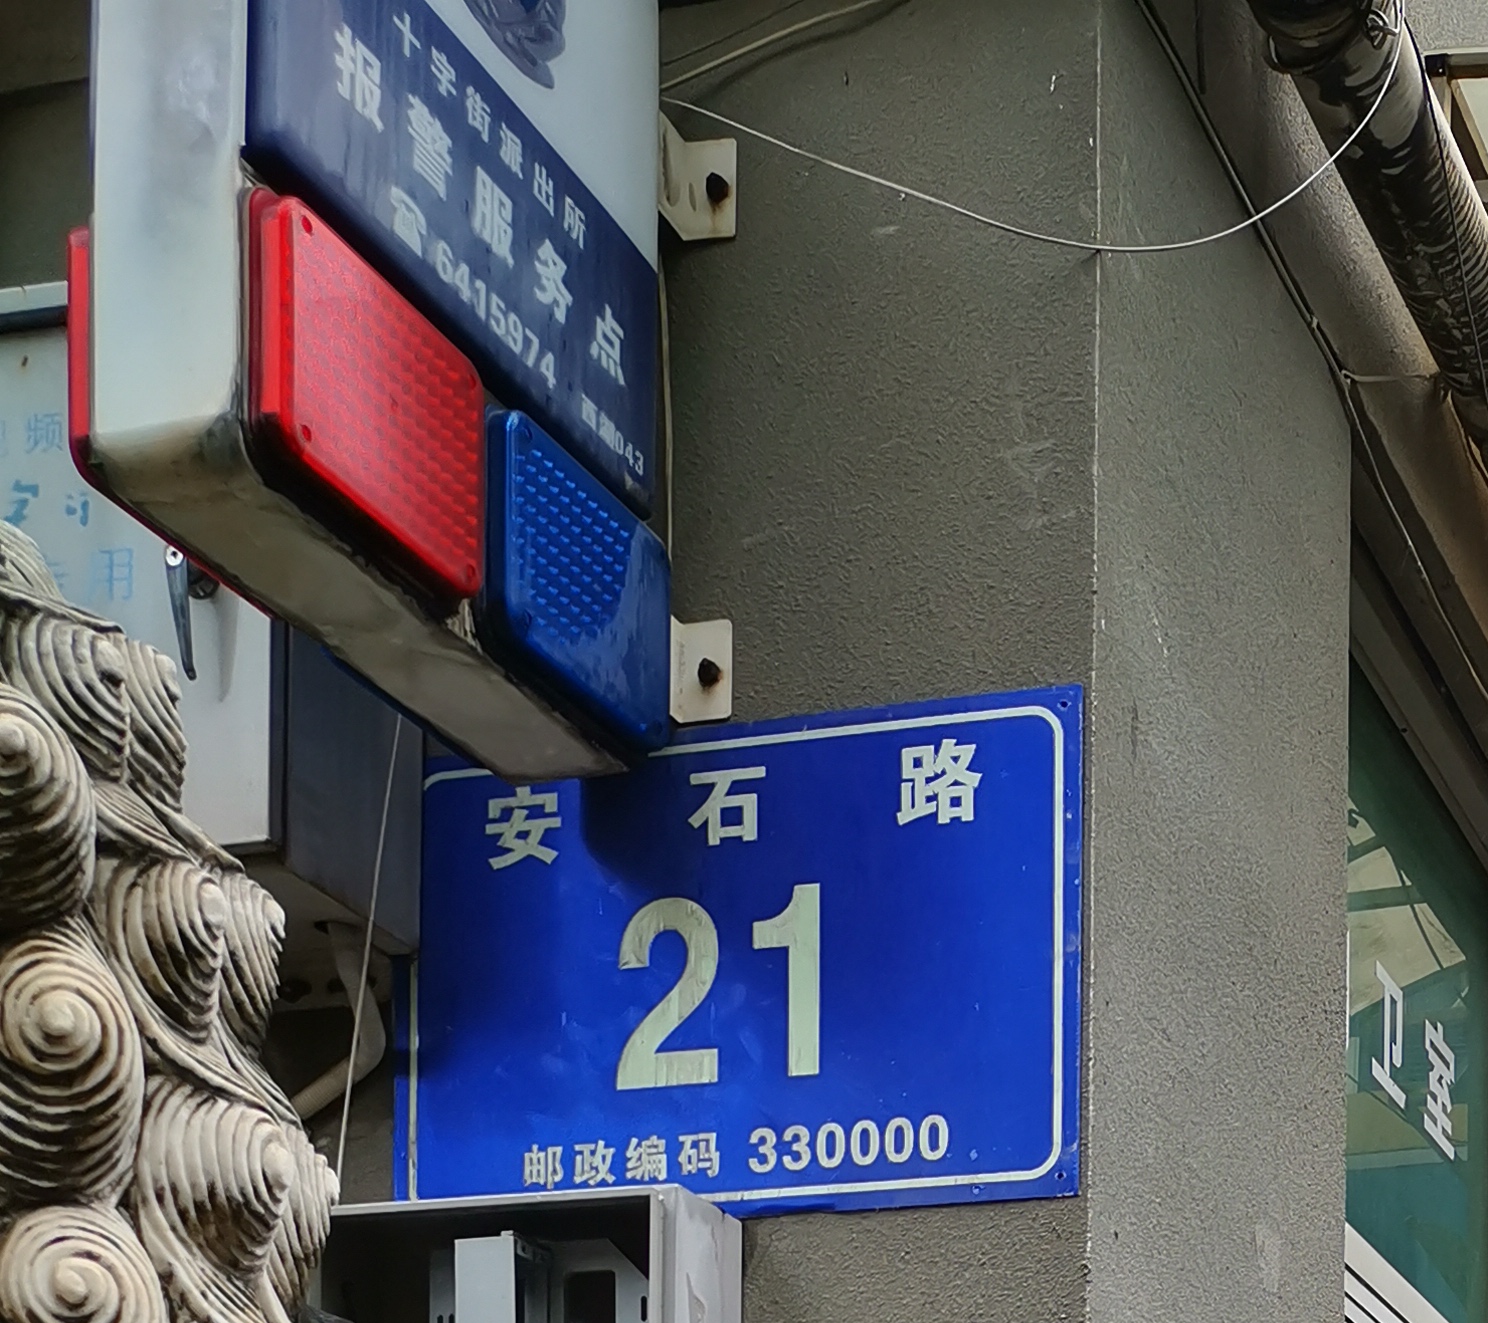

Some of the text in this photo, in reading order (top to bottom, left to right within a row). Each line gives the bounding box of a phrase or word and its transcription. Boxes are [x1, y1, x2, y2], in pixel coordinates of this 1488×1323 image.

[334, 21, 626, 387] 报警服务点
[393, 11, 587, 250] 十字街派出所
[434, 239, 557, 390] 6415974
[484, 738, 983, 870] 安石路
[616, 882, 821, 1092] 21
[522, 1113, 950, 1190] 邮政编码 330000
